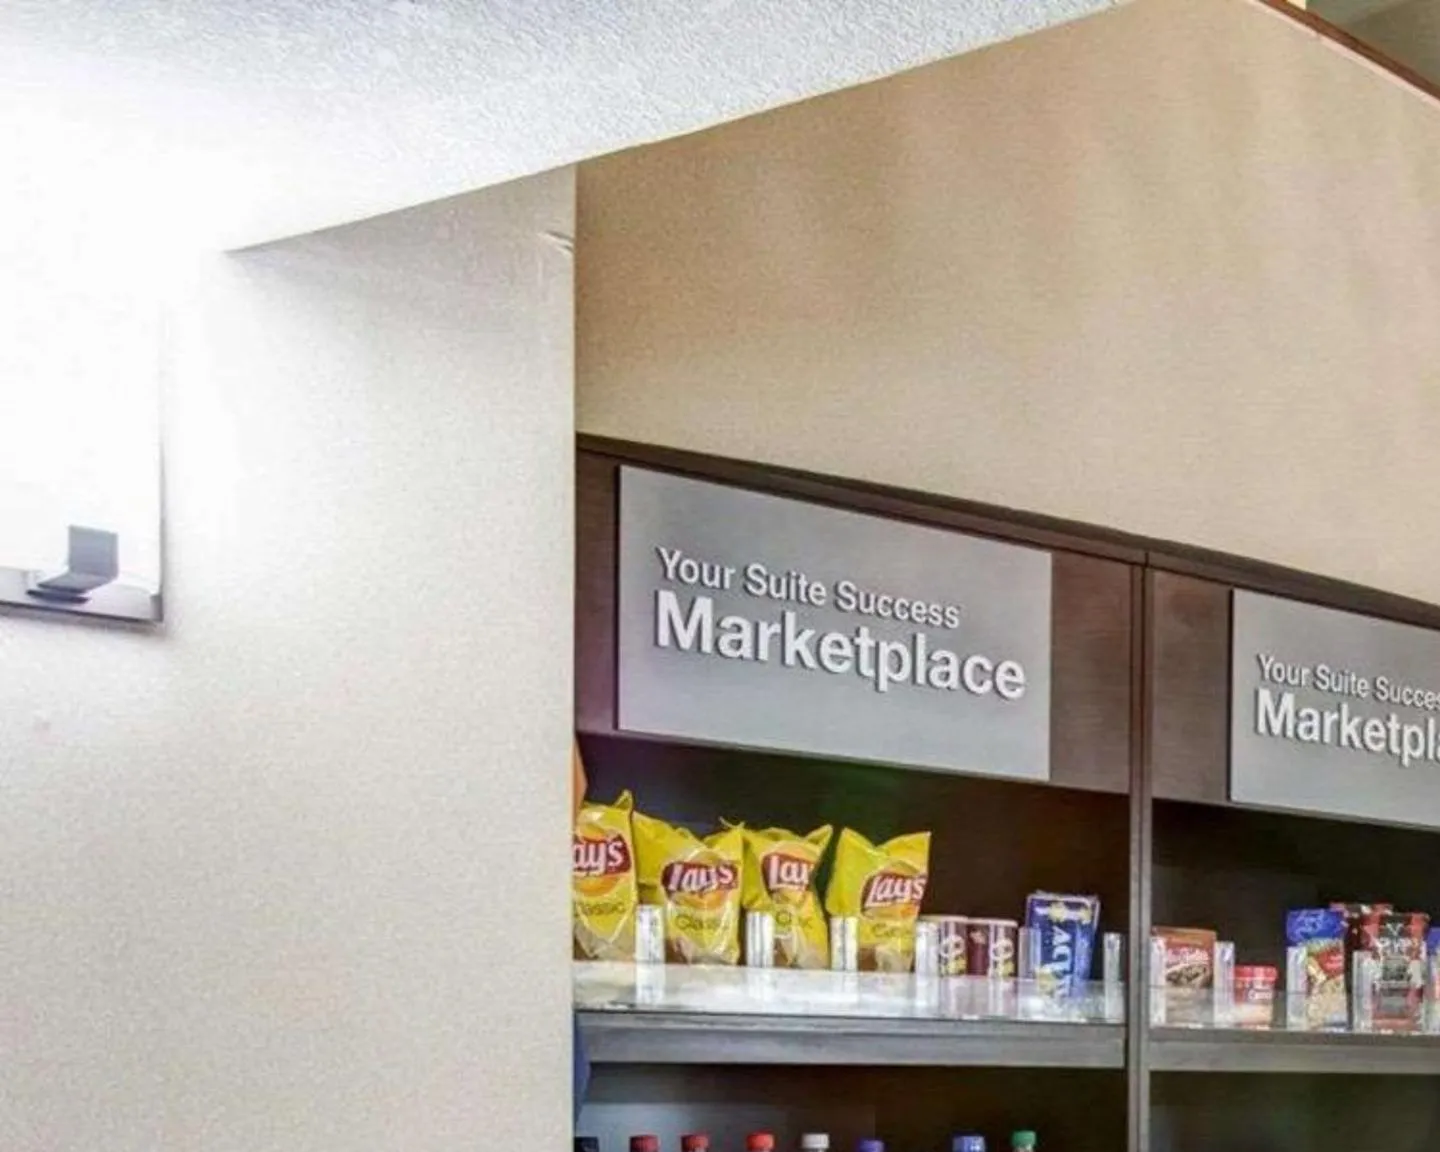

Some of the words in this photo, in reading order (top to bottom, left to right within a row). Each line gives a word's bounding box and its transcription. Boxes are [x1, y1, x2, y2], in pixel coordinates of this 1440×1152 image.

[655, 547, 735, 590] Your
[743, 563, 827, 606] Suite
[835, 581, 960, 629] Success
[655, 590, 1027, 700] Marketplace
[1258, 653, 1309, 686] Your
[1313, 664, 1370, 699] Suite
